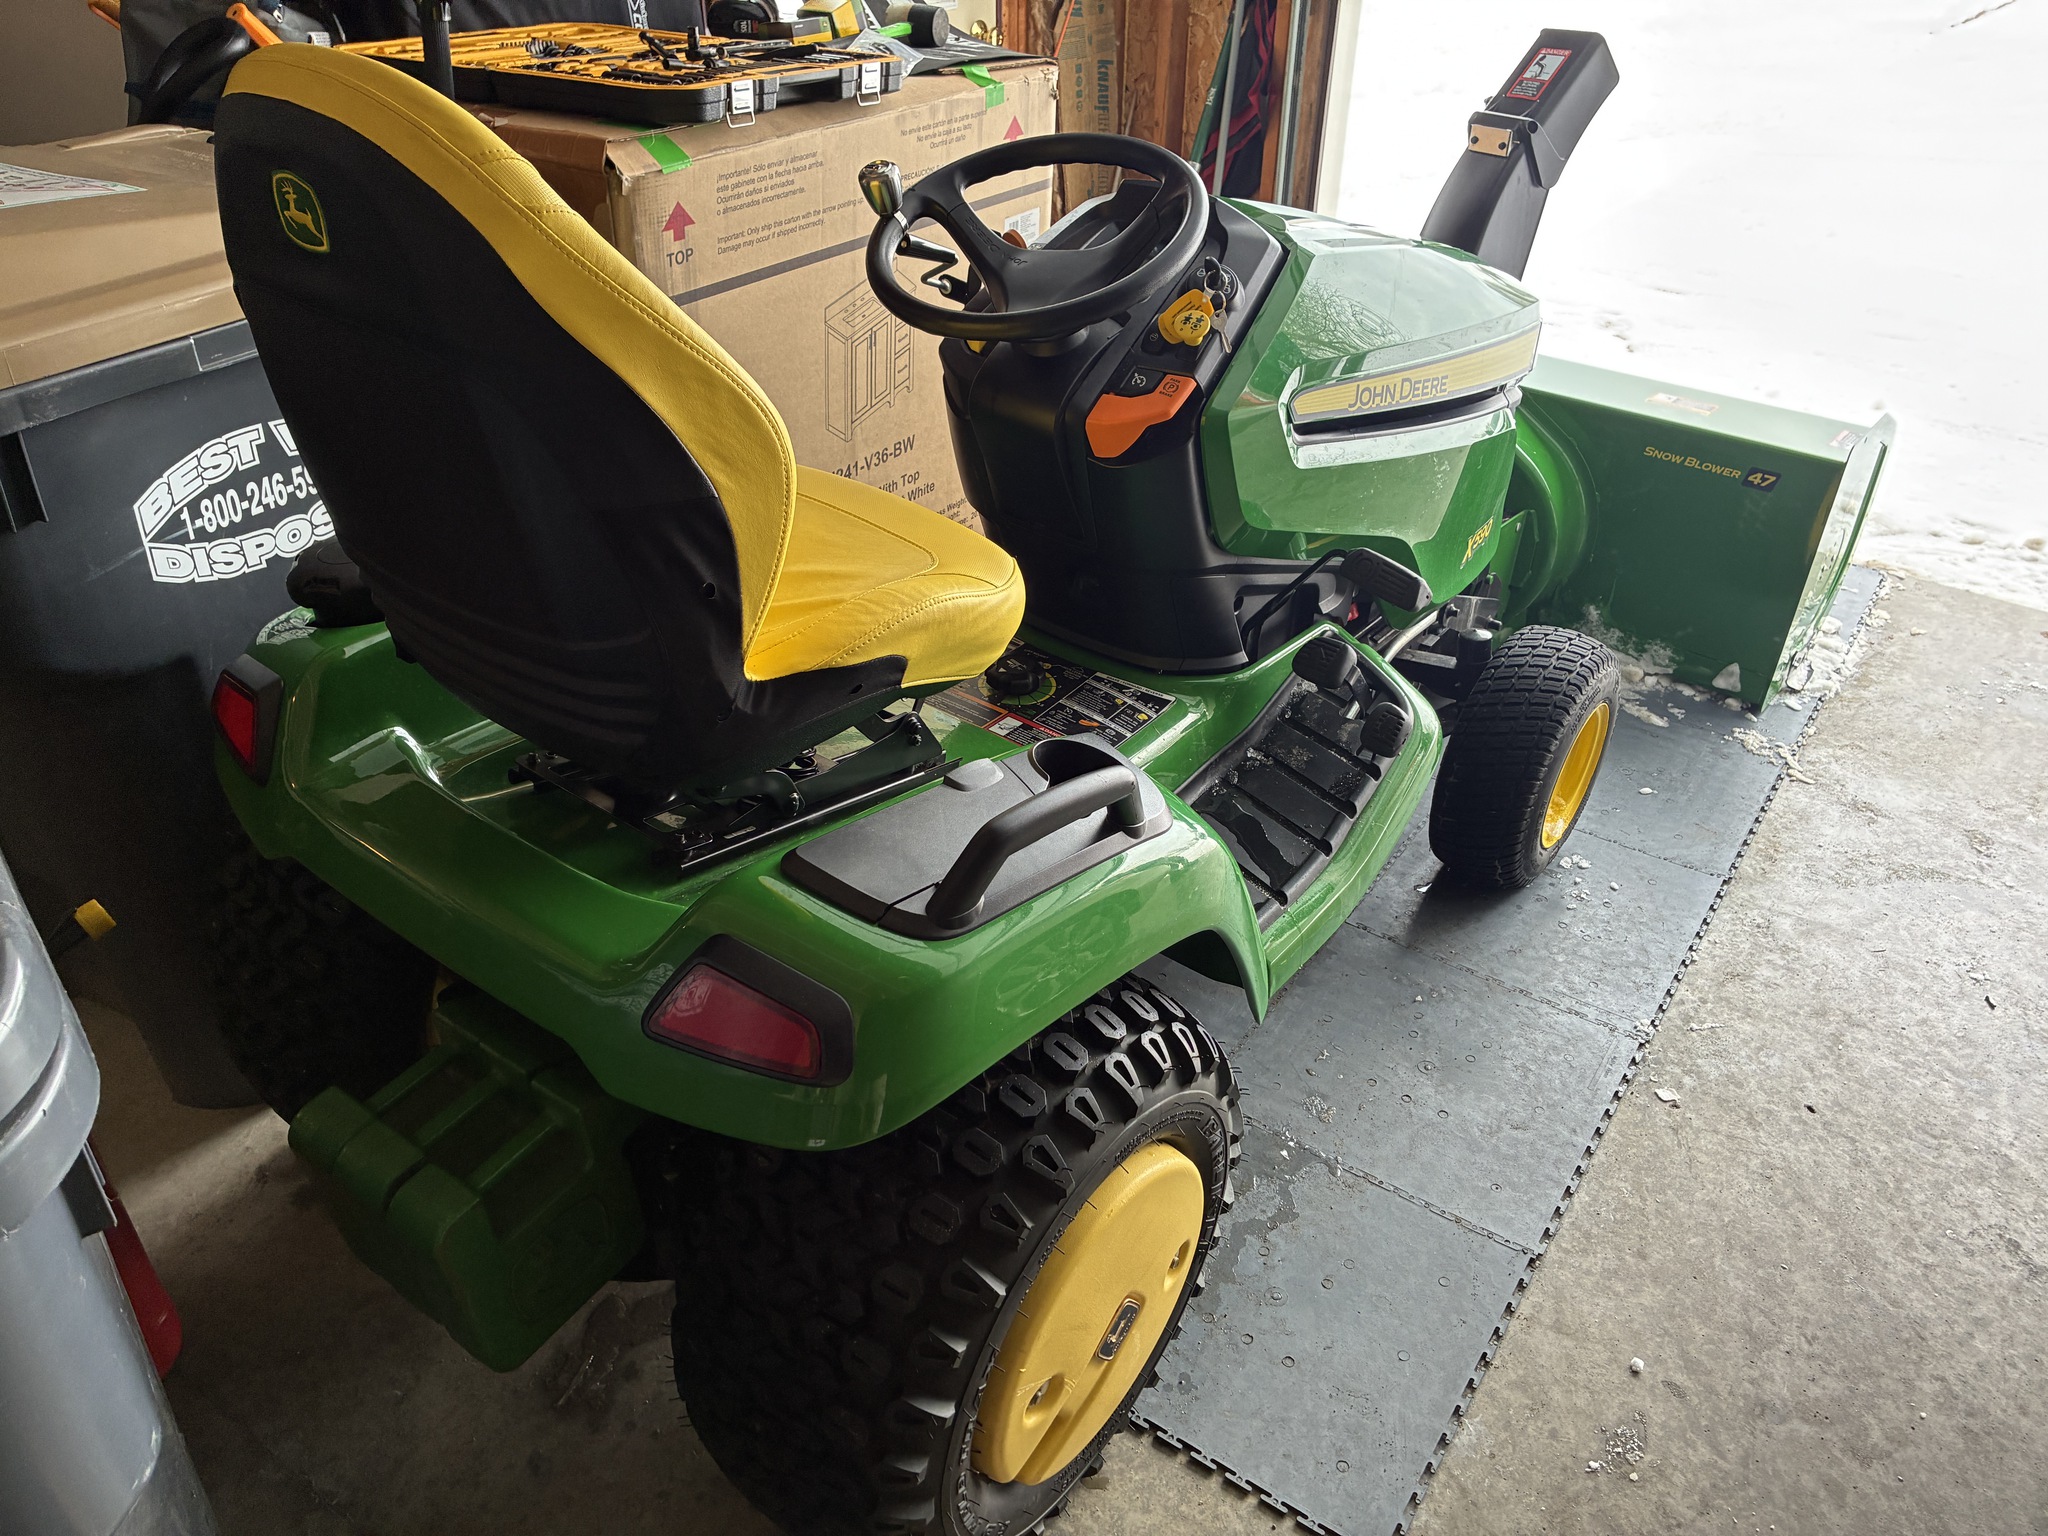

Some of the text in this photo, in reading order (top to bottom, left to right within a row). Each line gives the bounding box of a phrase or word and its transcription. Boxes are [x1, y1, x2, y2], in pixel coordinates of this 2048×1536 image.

[942, 128, 952, 136] caja
[963, 123, 972, 131] lado
[959, 113, 969, 122] parte
[753, 163, 766, 173] Sólo
[767, 159, 784, 169] enviar
[790, 151, 818, 164] almacenar
[716, 160, 824, 193] este gabinete con la flecha hacia arriba.
[745, 187, 763, 198] daños
[770, 178, 795, 191] enviados
[722, 198, 760, 215] almacenados
[761, 186, 806, 203] incorrectamente.
[717, 230, 745, 244] Important:
[747, 226, 760, 236] Only
[761, 223, 773, 233] ship
[773, 220, 783, 228] this
[783, 216, 801, 226] carton
[801, 211, 812, 220] with
[812, 209, 821, 217] the
[821, 206, 836, 214] arrow
[837, 199, 857, 211] pointing
[717, 218, 825, 255] Damage may occur if shipped incorrectly.
[666, 247, 694, 268] TOP
[1348, 375, 1449, 410] JOHN DEERE
[900, 470, 920, 487] Top
[1643, 446, 1777, 487] SNOW BLOWER 47
[133, 423, 266, 542] BEST
[907, 482, 935, 502] White
